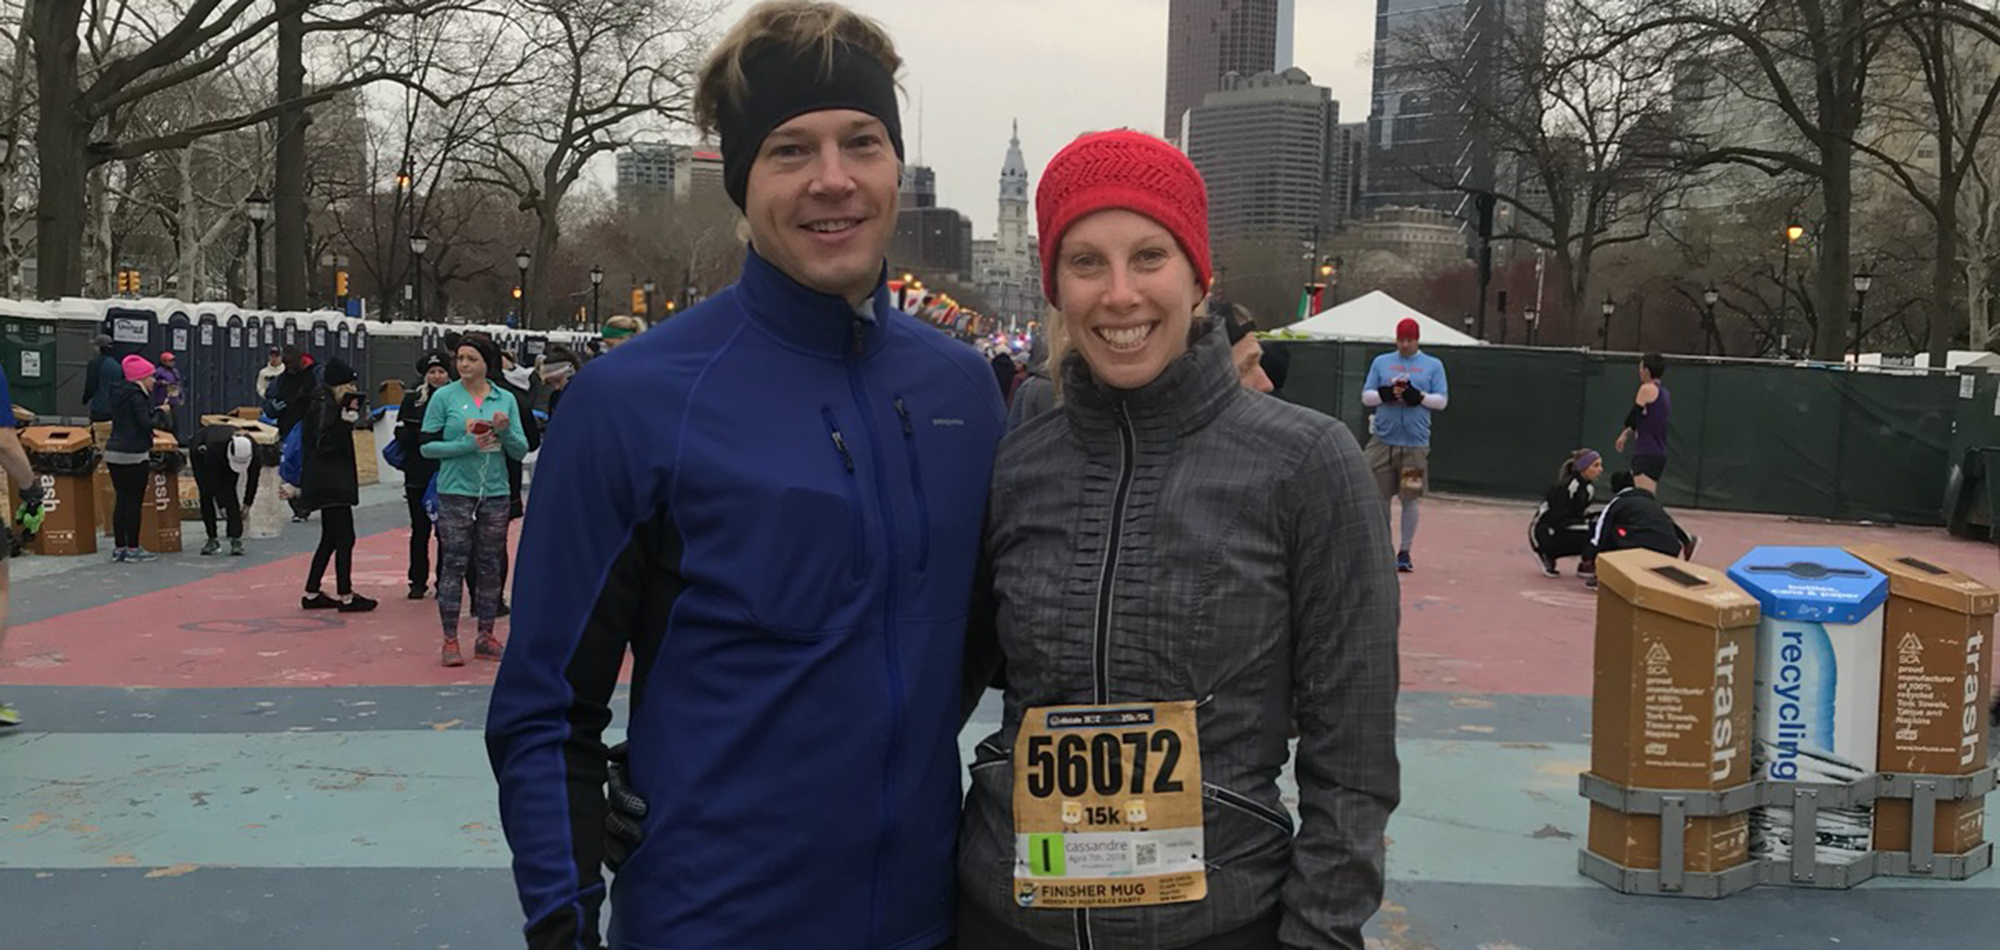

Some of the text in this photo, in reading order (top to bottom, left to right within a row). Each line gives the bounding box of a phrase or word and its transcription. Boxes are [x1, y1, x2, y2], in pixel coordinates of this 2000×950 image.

[41, 474, 61, 512] ash
[154, 474, 171, 511] ash
[1646, 665, 1669, 675] SCA
[1898, 666, 1924, 674] proud
[1899, 654, 1920, 664] SCA
[1712, 641, 1739, 780] trash
[1770, 631, 1806, 781] recycling
[1961, 630, 1984, 766] trash
[1027, 728, 1184, 799] 56072
[1084, 806, 1121, 825] 15k
[1065, 839, 1129, 853] cassandre
[1041, 884, 1106, 898] FINISHER
[1111, 882, 1146, 896] MUG
